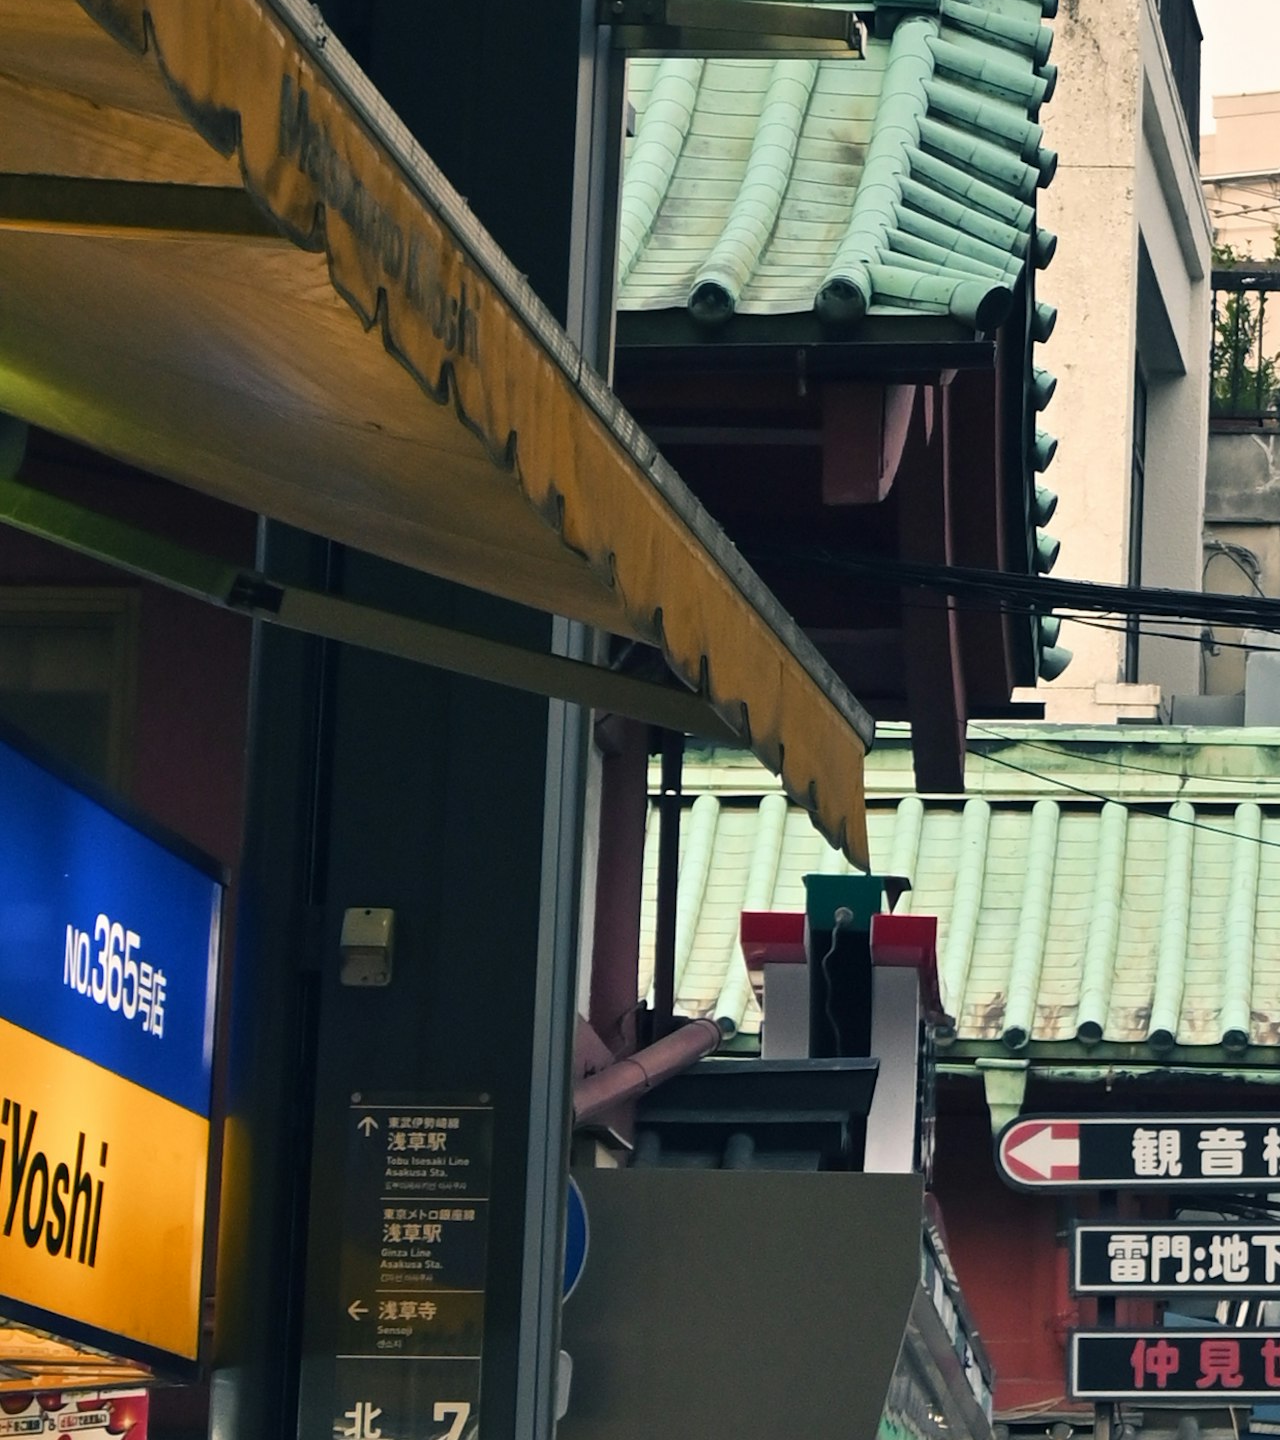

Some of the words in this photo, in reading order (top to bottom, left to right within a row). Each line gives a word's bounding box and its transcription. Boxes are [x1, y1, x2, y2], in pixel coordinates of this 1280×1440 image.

[387, 1132, 447, 1151] 浅草駅
[449, 1156, 470, 1166] Line
[385, 1167, 427, 1177] Asakusa
[429, 1168, 448, 1178] Sta.
[382, 1223, 442, 1243] 浅草駅
[410, 1248, 431, 1258] Line
[380, 1259, 422, 1269] Asakusa
[424, 1259, 443, 1270] Sta.
[378, 1301, 437, 1320] 浅草寺
[344, 1401, 382, 1439] 北
